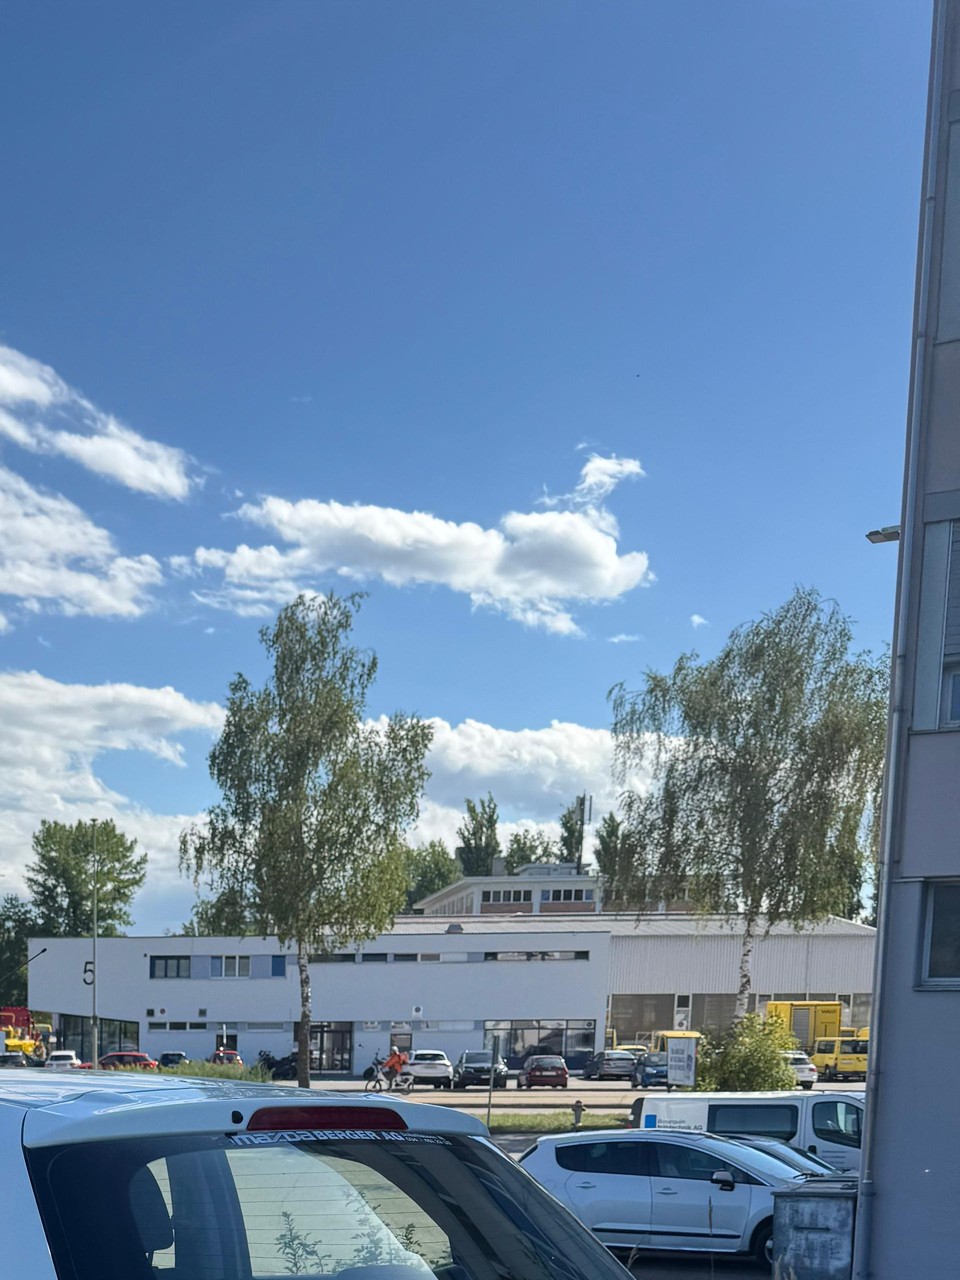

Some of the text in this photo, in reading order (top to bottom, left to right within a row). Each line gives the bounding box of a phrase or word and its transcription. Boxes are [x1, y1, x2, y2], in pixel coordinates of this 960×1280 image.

[83, 961, 95, 985] 5
[231, 1131, 316, 1146] mazda
[312, 1130, 382, 1140] BERGER
[381, 1131, 405, 1141] AG
